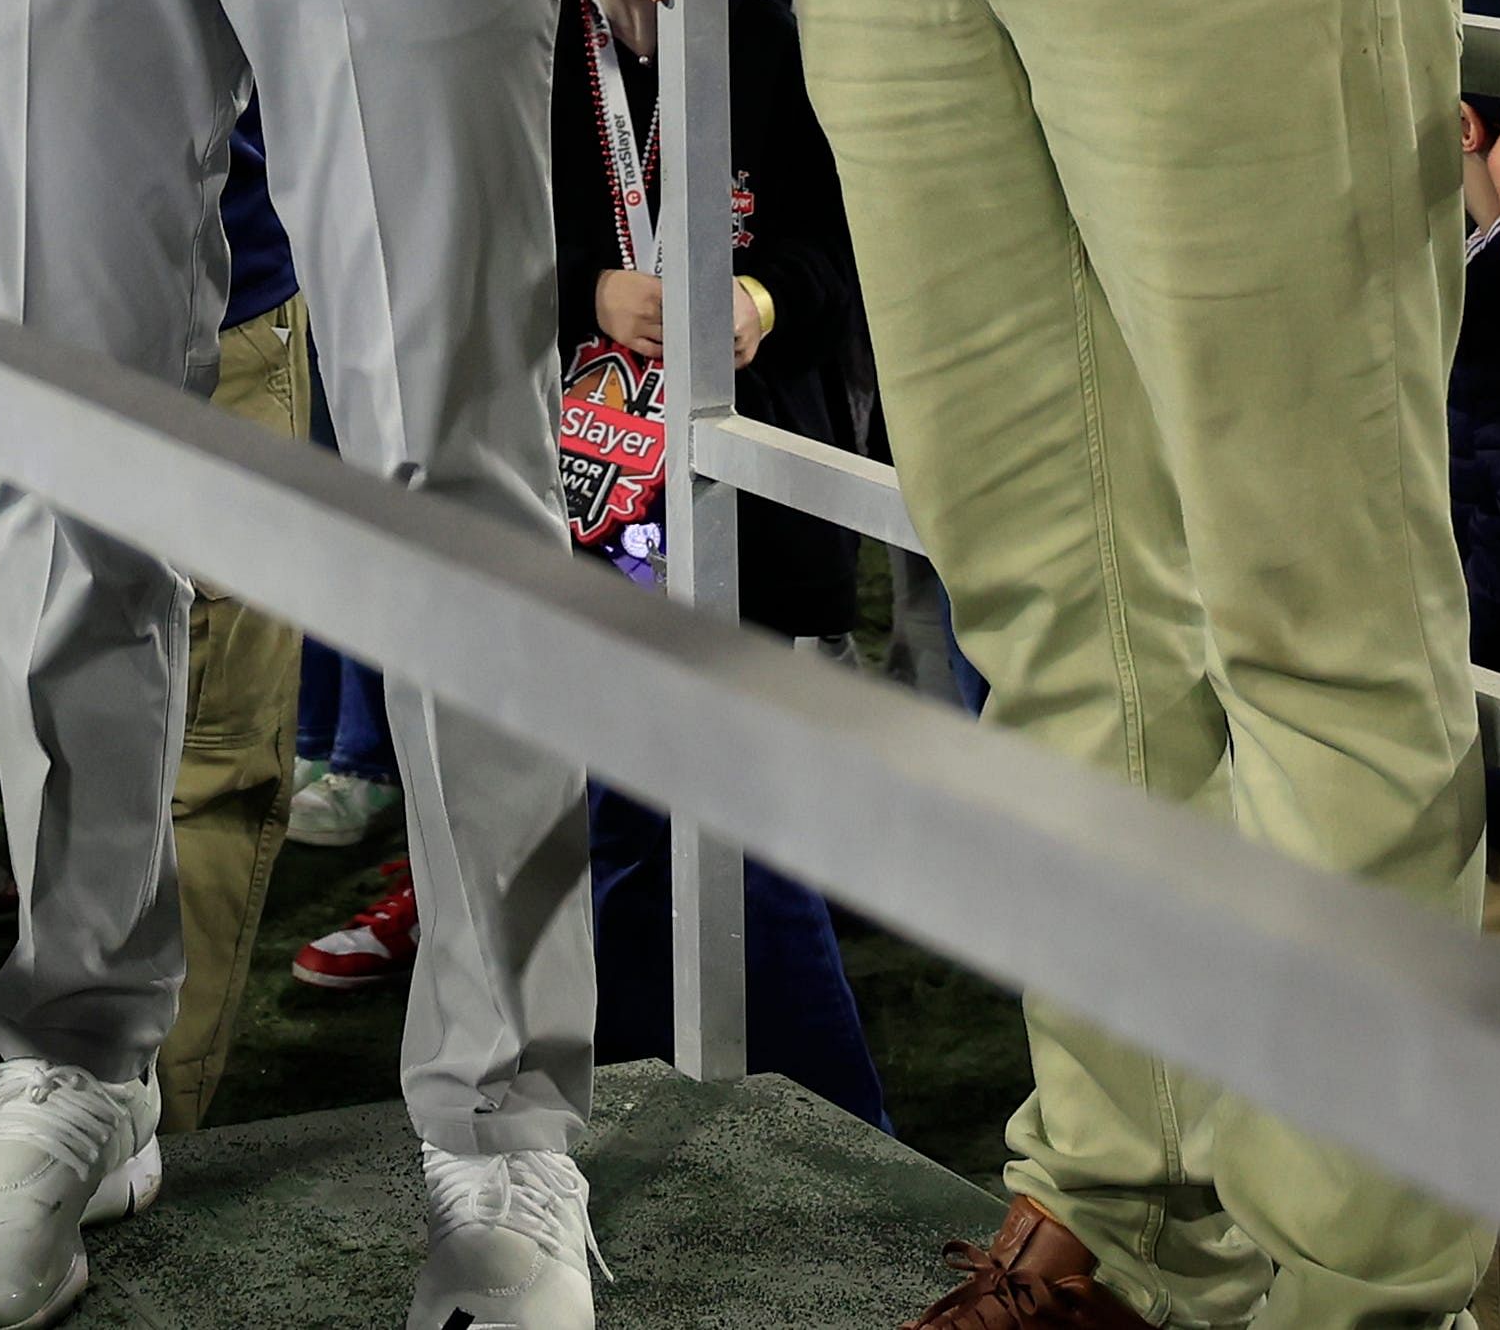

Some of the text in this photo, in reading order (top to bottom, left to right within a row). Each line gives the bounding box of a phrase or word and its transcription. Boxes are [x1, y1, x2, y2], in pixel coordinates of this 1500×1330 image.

[613, 113, 638, 188] TaxSlayer
[561, 406, 656, 457] Slayer
[562, 455, 604, 479] TOR
[562, 471, 594, 498] WL
